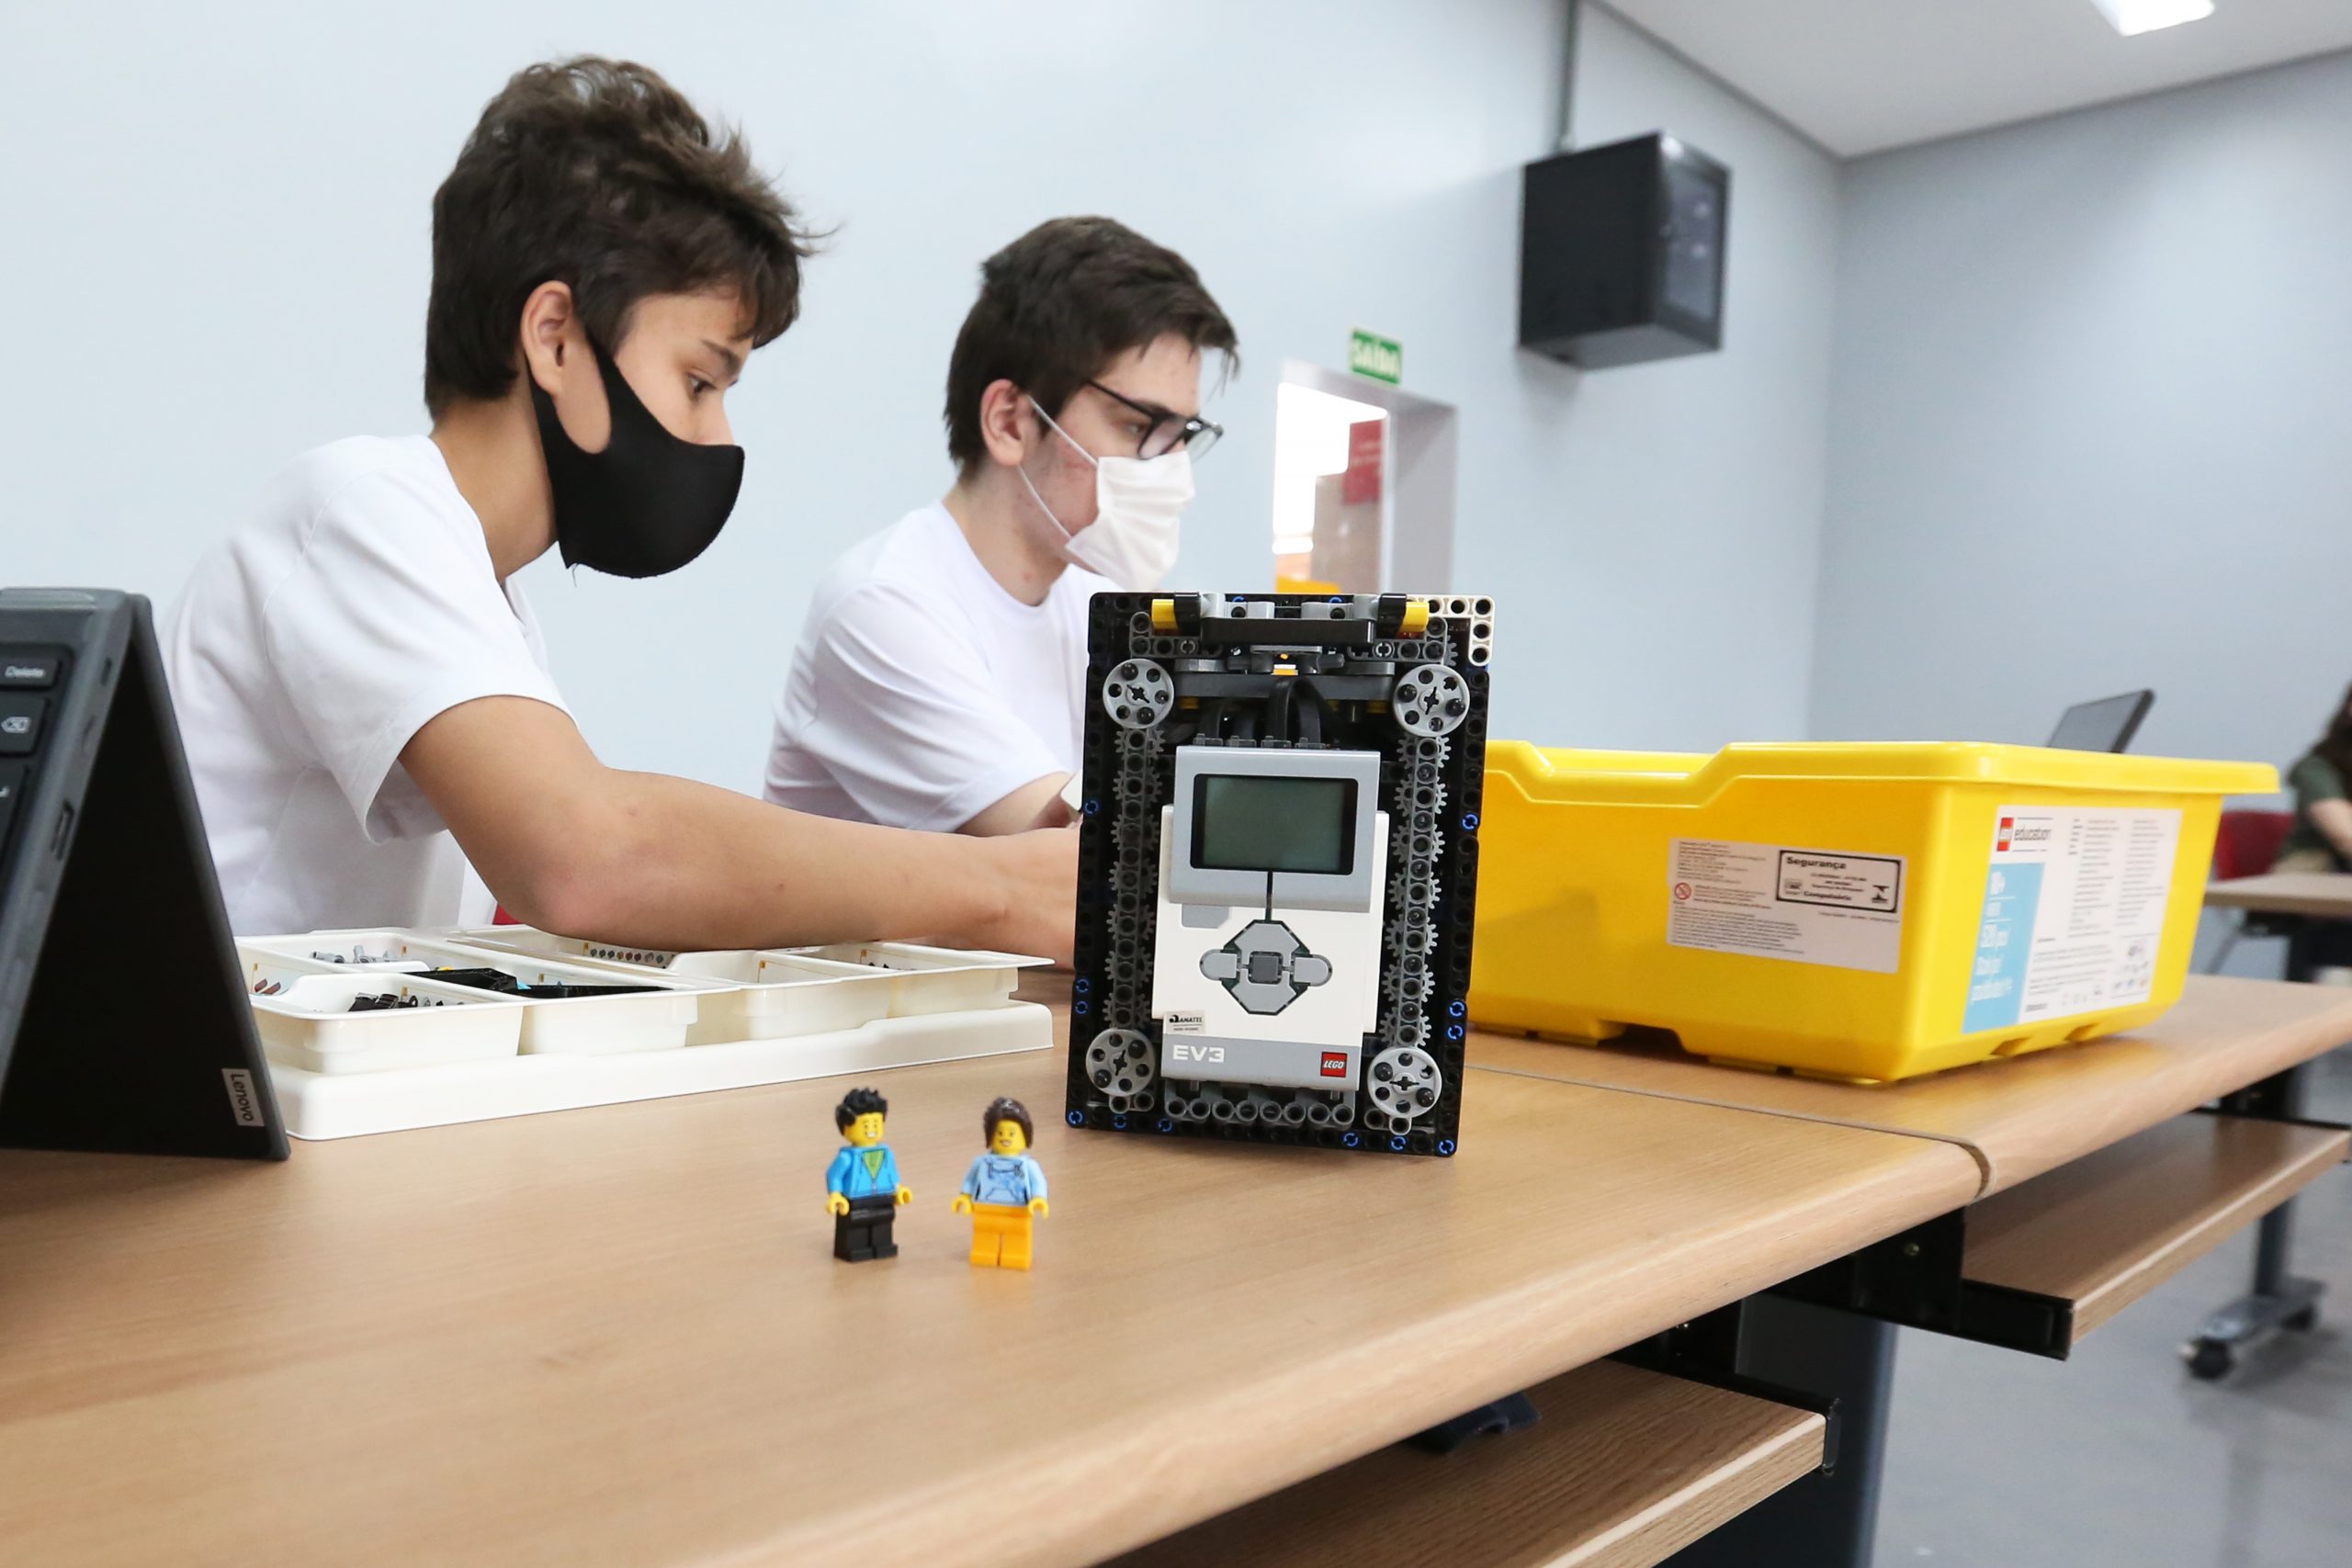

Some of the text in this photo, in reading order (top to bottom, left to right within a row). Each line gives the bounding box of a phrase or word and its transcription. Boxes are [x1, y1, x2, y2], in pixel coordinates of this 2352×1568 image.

[1787, 856, 1847, 871] Segurança
[1173, 1043, 1225, 1064] EV3
[1323, 1059, 1345, 1070] LEGO
[231, 1073, 254, 1122] Lenovo
